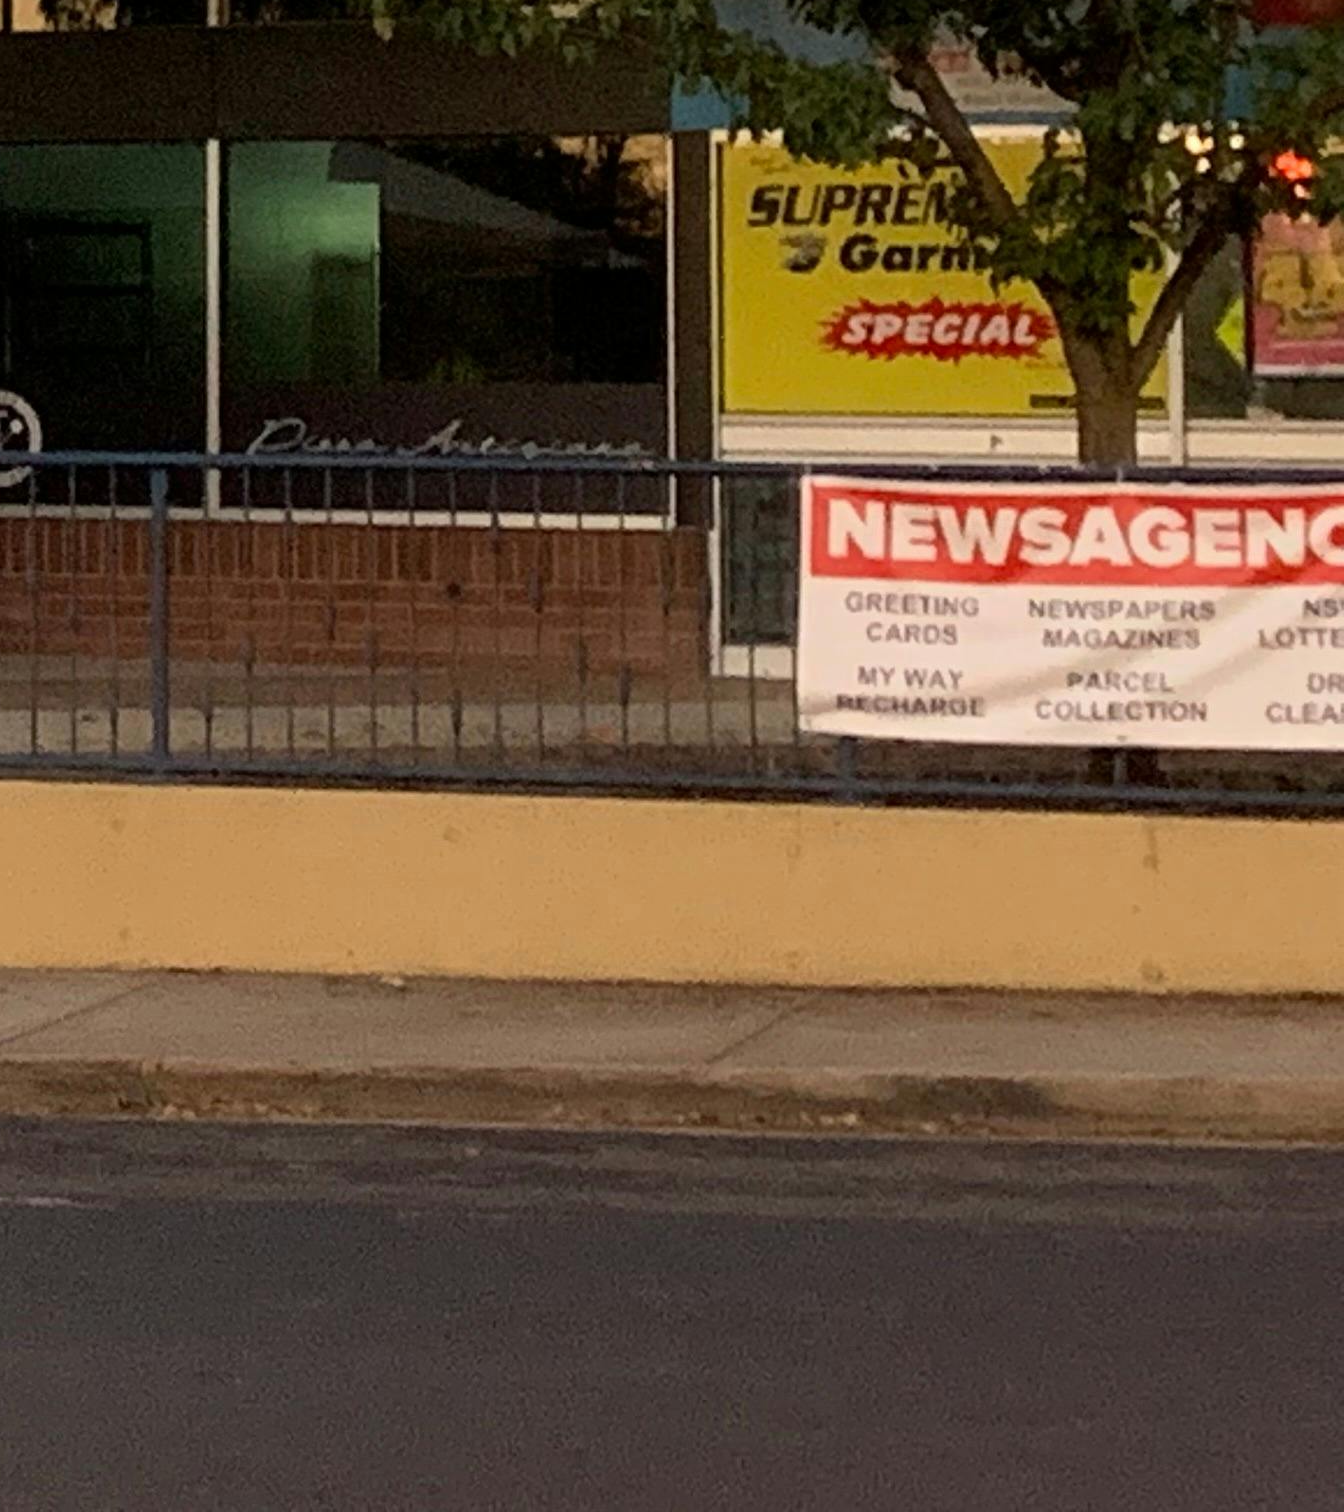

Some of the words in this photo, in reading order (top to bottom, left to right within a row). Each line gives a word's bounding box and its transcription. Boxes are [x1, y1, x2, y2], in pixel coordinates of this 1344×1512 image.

[841, 312, 1038, 347] SPECIAL
[827, 498, 1344, 568] NEWSAGENC
[844, 591, 980, 617] GREETING
[1028, 597, 1216, 622] NEWSPAPERS
[1302, 598, 1344, 618] NS
[865, 621, 959, 646] CARDS
[1041, 628, 1201, 650] MAGAZINES
[857, 665, 895, 687] MY
[904, 668, 963, 690] WAY
[1066, 671, 1174, 692] PARCEL
[835, 694, 986, 718] RECHARGE
[1035, 699, 1208, 722] COLLECTION
